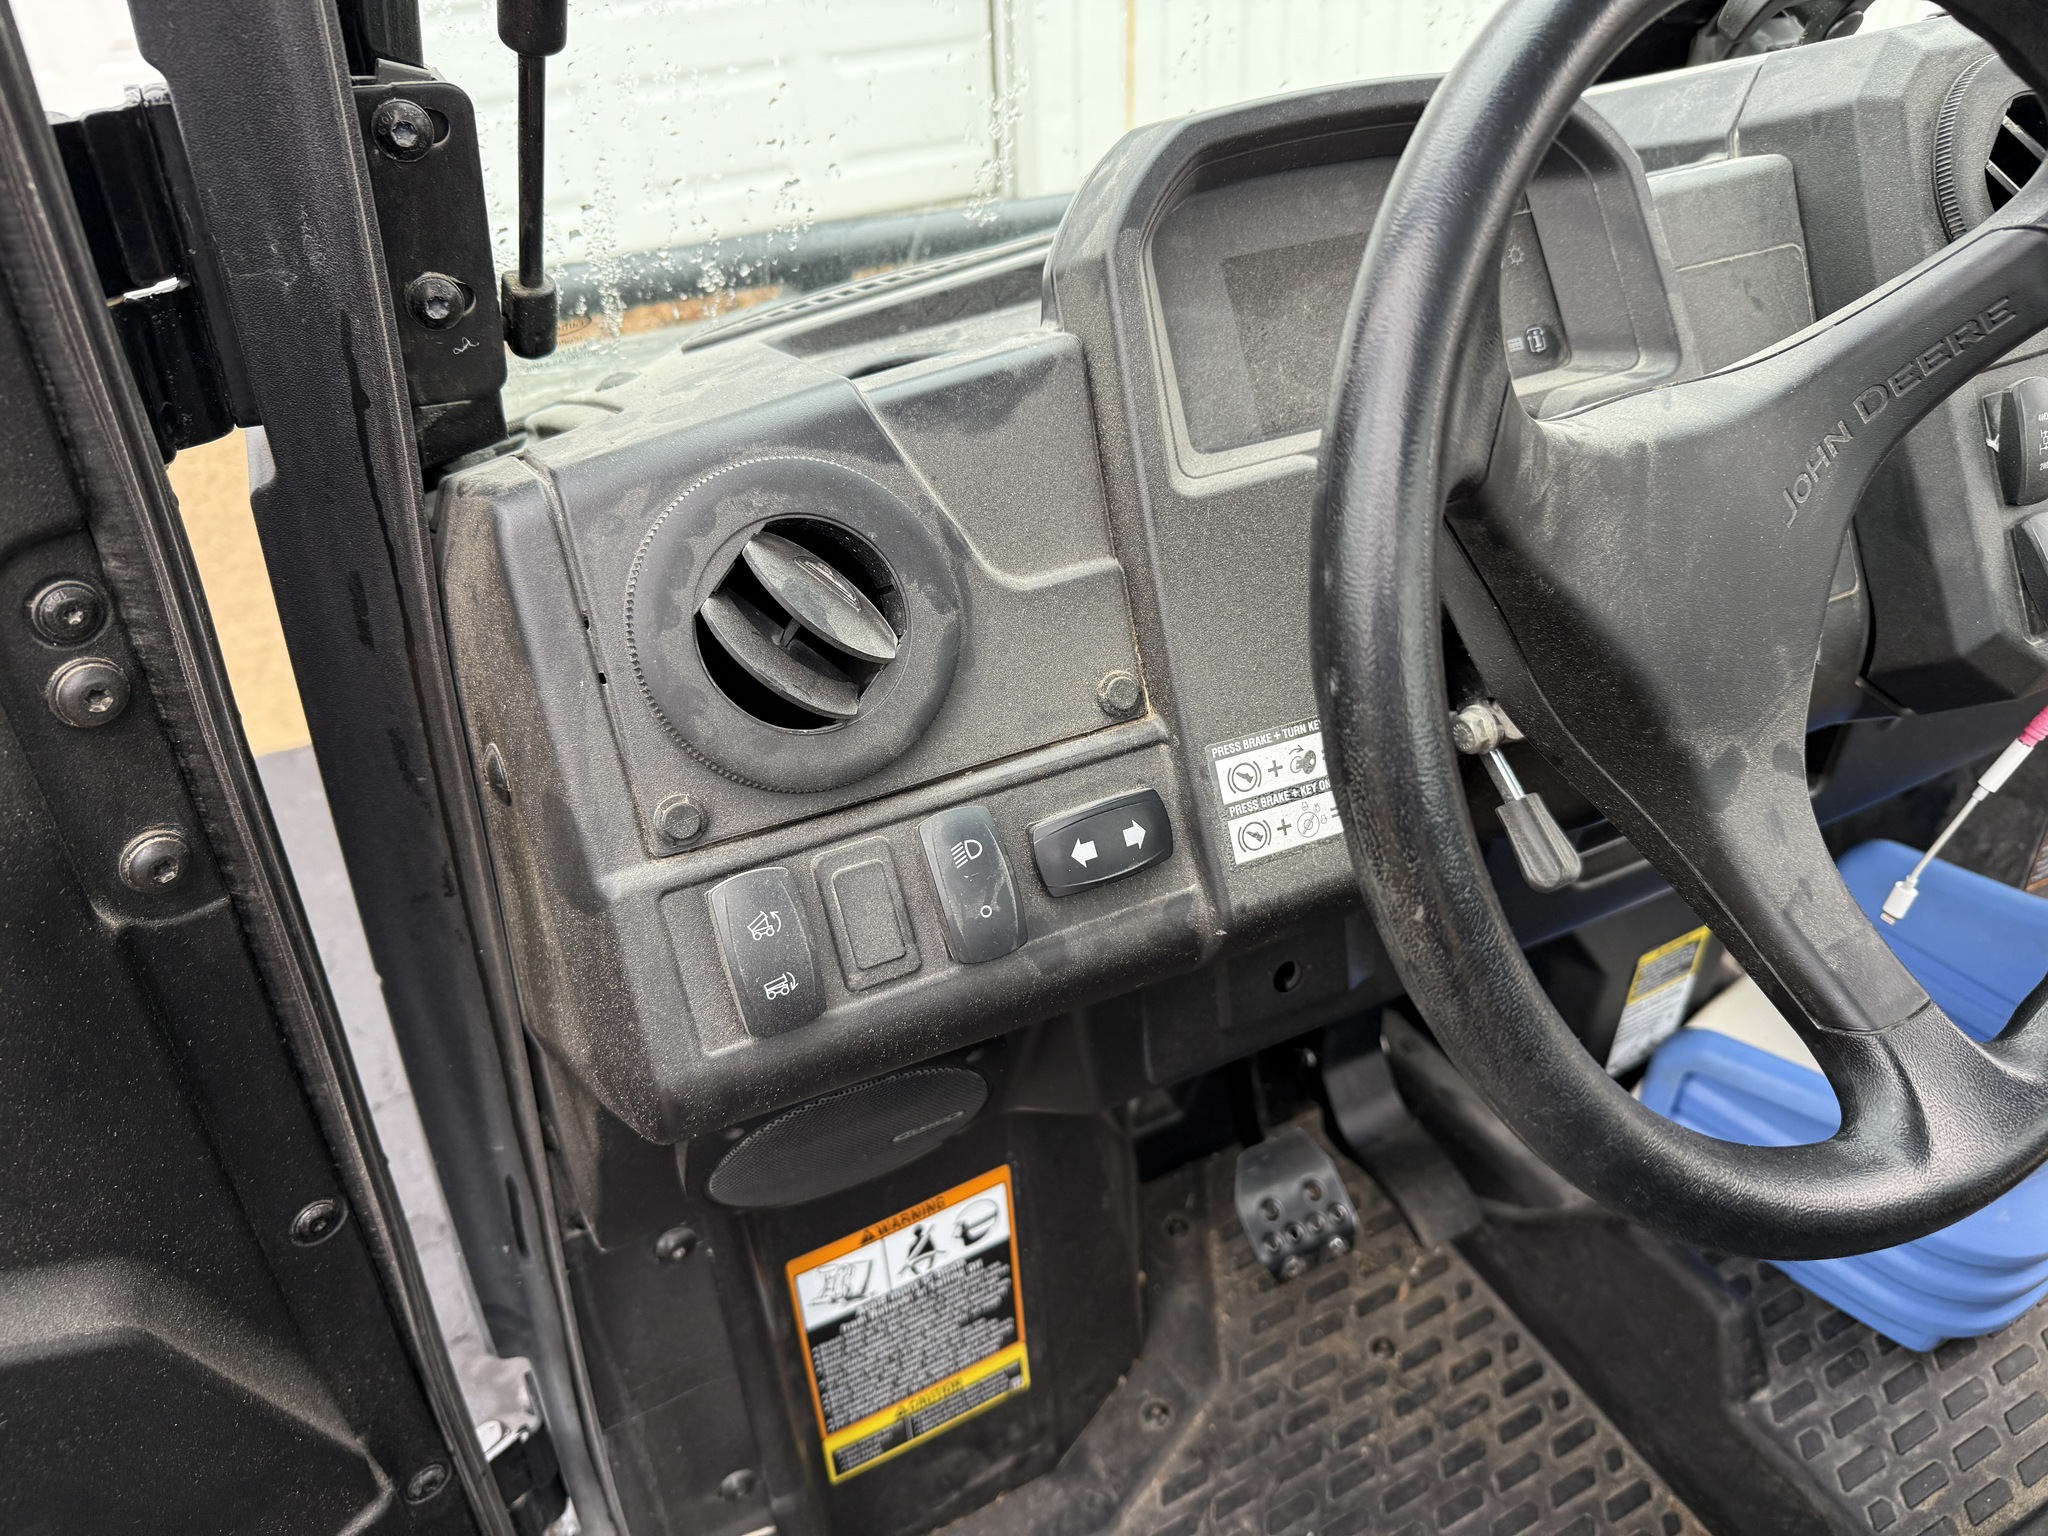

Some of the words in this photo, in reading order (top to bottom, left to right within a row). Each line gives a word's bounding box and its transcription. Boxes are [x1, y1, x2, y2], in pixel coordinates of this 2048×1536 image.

[1782, 420, 1854, 528] JOHN
[1852, 295, 2017, 425] DEERE
[1211, 741, 1241, 759] PRESS
[1242, 733, 1273, 750] BRAKE
[1282, 723, 1308, 739] TURN
[1229, 800, 1259, 818] PRESS
[1260, 791, 1290, 808] BRAKE
[1300, 782, 1317, 797] KEY
[1319, 778, 1331, 791] ON
[878, 1195, 947, 1236] WARNING
